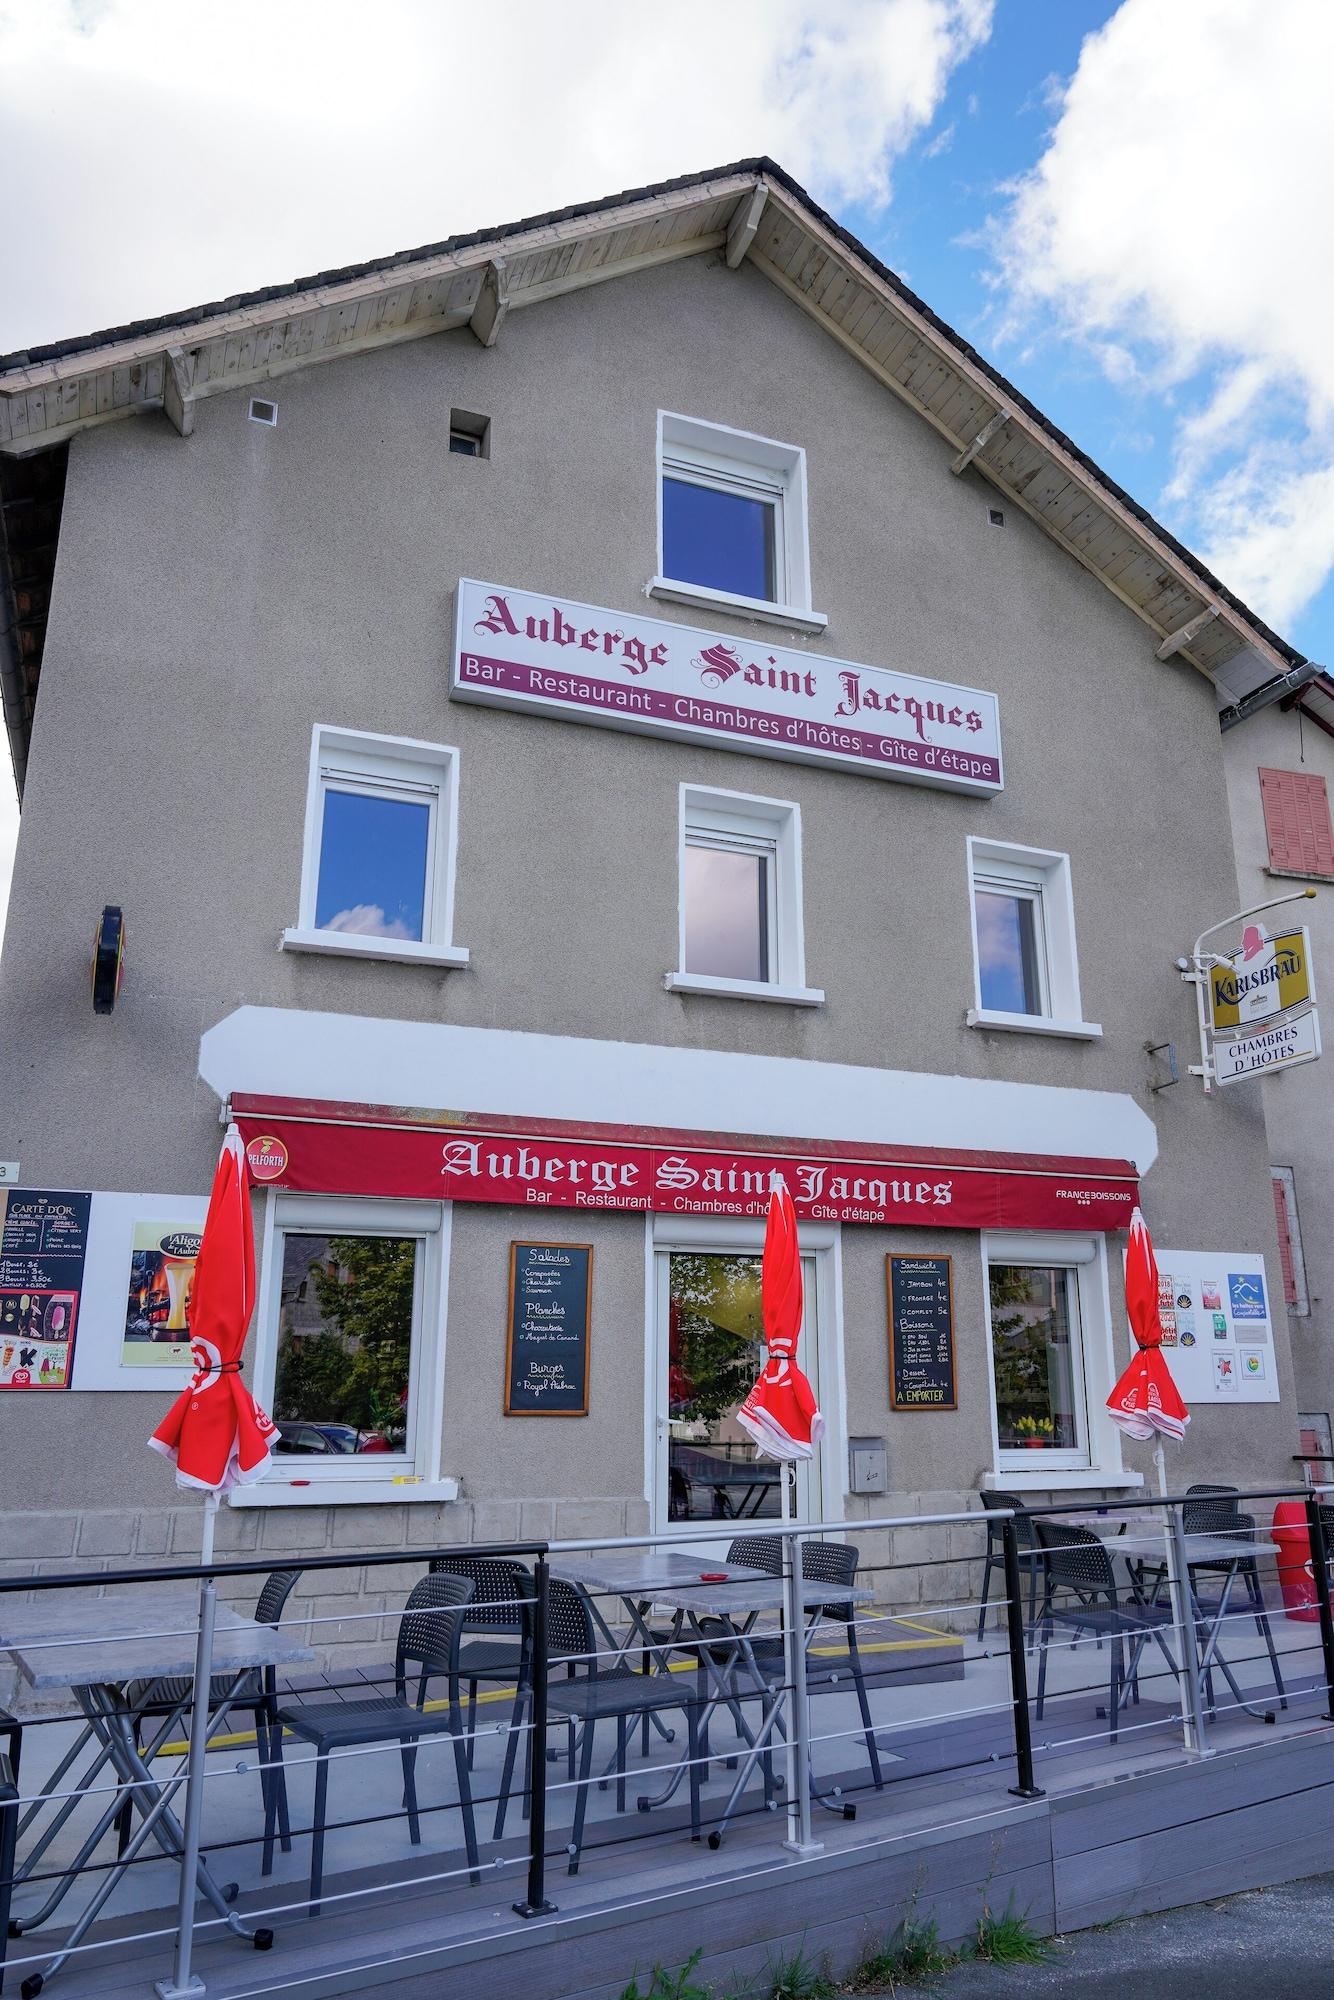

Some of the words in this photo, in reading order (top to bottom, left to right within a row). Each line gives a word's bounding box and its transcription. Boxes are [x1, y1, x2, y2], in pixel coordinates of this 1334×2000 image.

[473, 595, 670, 675] Auberge
[690, 643, 817, 698] Saint
[835, 671, 983, 744] Jacques
[466, 657, 505, 681] Bar
[530, 670, 652, 710] Restaurant
[675, 699, 780, 736] Chambres
[786, 719, 861, 750] d'hôtes
[879, 738, 918, 761] Gîte
[924, 747, 992, 777] d'étape
[1229, 1026, 1298, 1058] CHAMBRES
[248, 1153, 283, 1167] PELFORTH
[441, 1140, 640, 1191] Auberge
[794, 1165, 953, 1208] Jacques
[11, 1203, 45, 1214] CARTE
[526, 1188, 553, 1203] Bar
[576, 1190, 652, 1209] Restaurant
[673, 1196, 743, 1213] Chambres
[811, 1204, 838, 1218] Gîte
[842, 1207, 886, 1222] d'étape
[529, 1249, 570, 1263] Salades
[530, 1362, 564, 1380] Burger
[906, 1390, 944, 1402] EMPORTER
